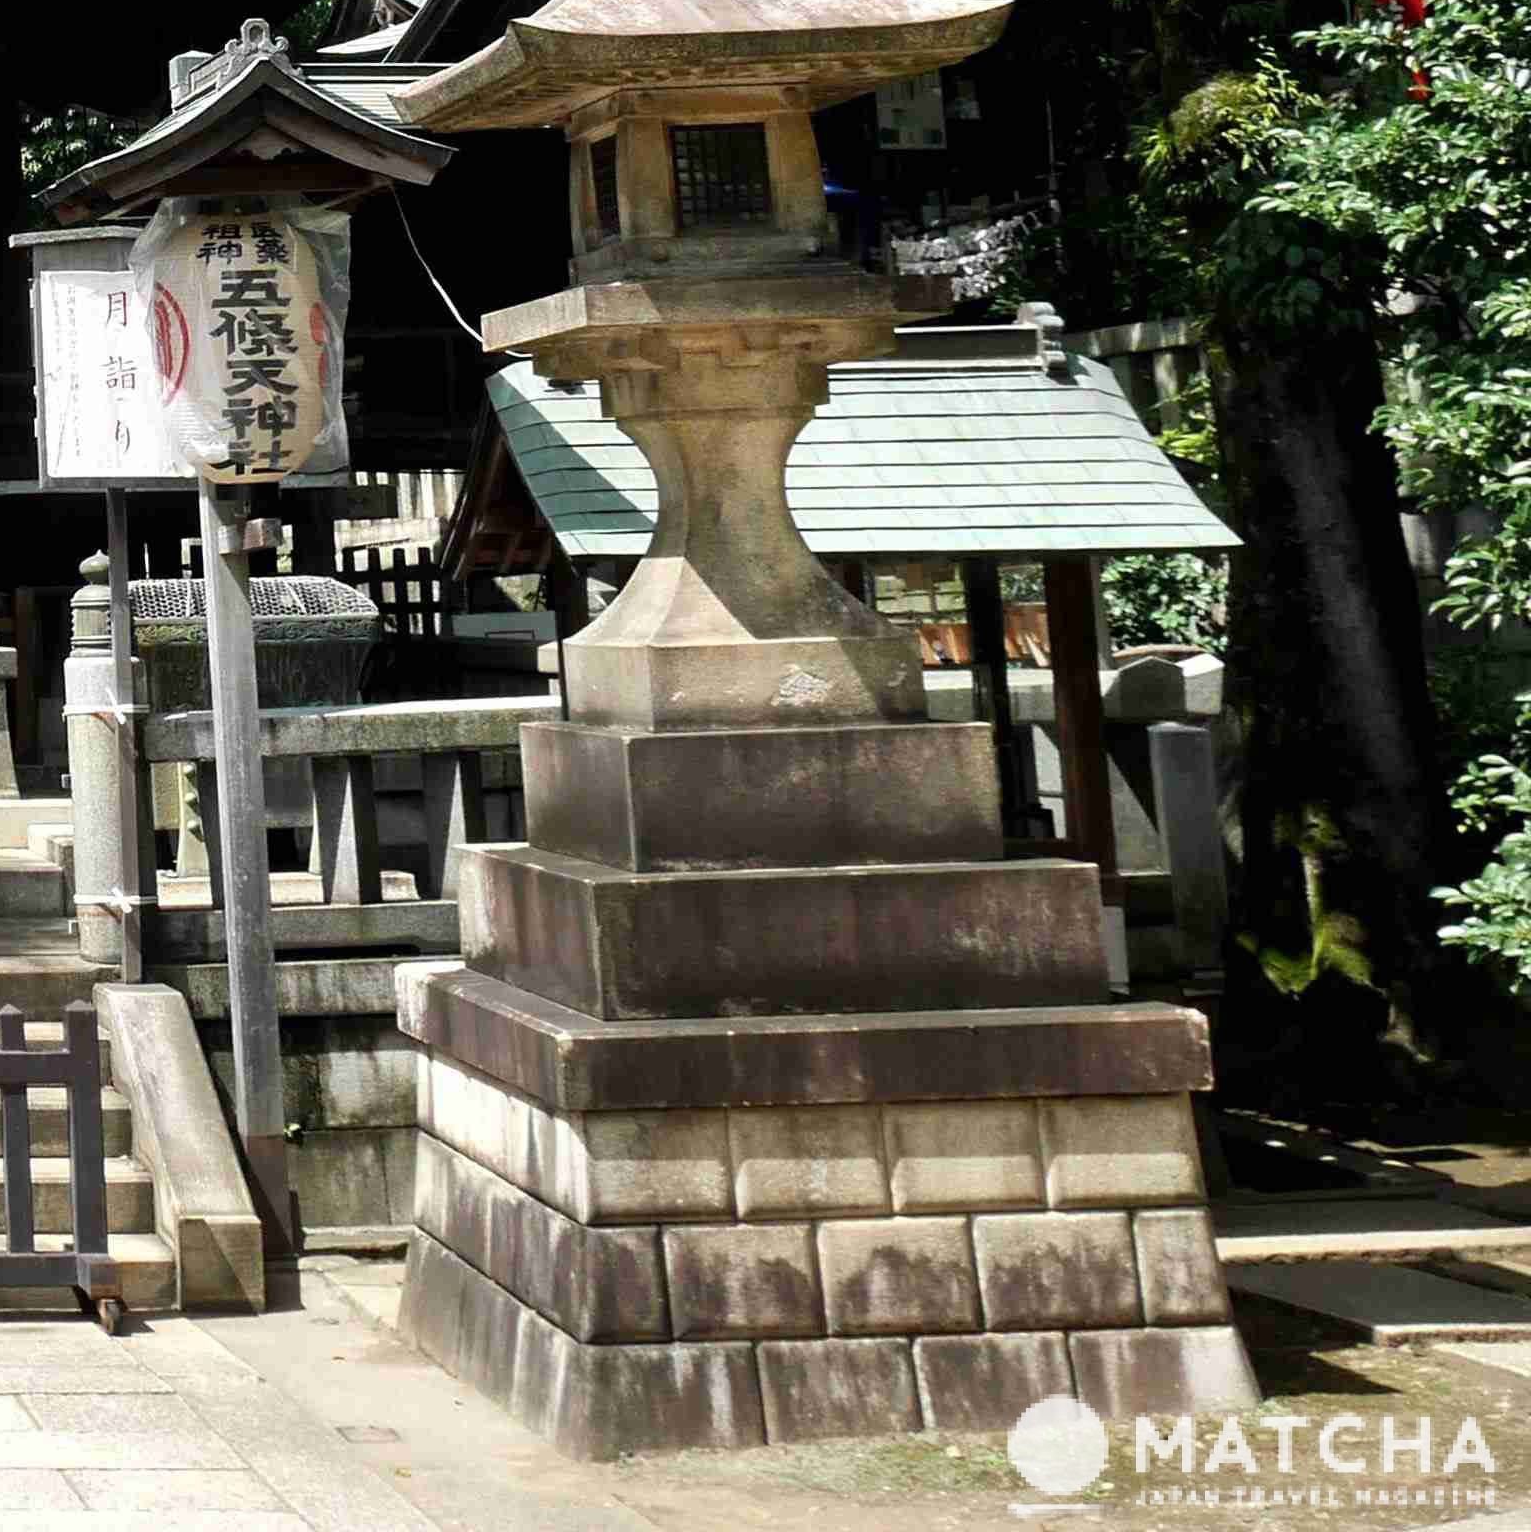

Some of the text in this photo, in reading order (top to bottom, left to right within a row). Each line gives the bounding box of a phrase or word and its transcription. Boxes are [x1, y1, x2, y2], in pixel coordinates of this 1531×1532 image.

[196, 223, 243, 265] 祖神
[209, 268, 299, 476] 五條天神社
